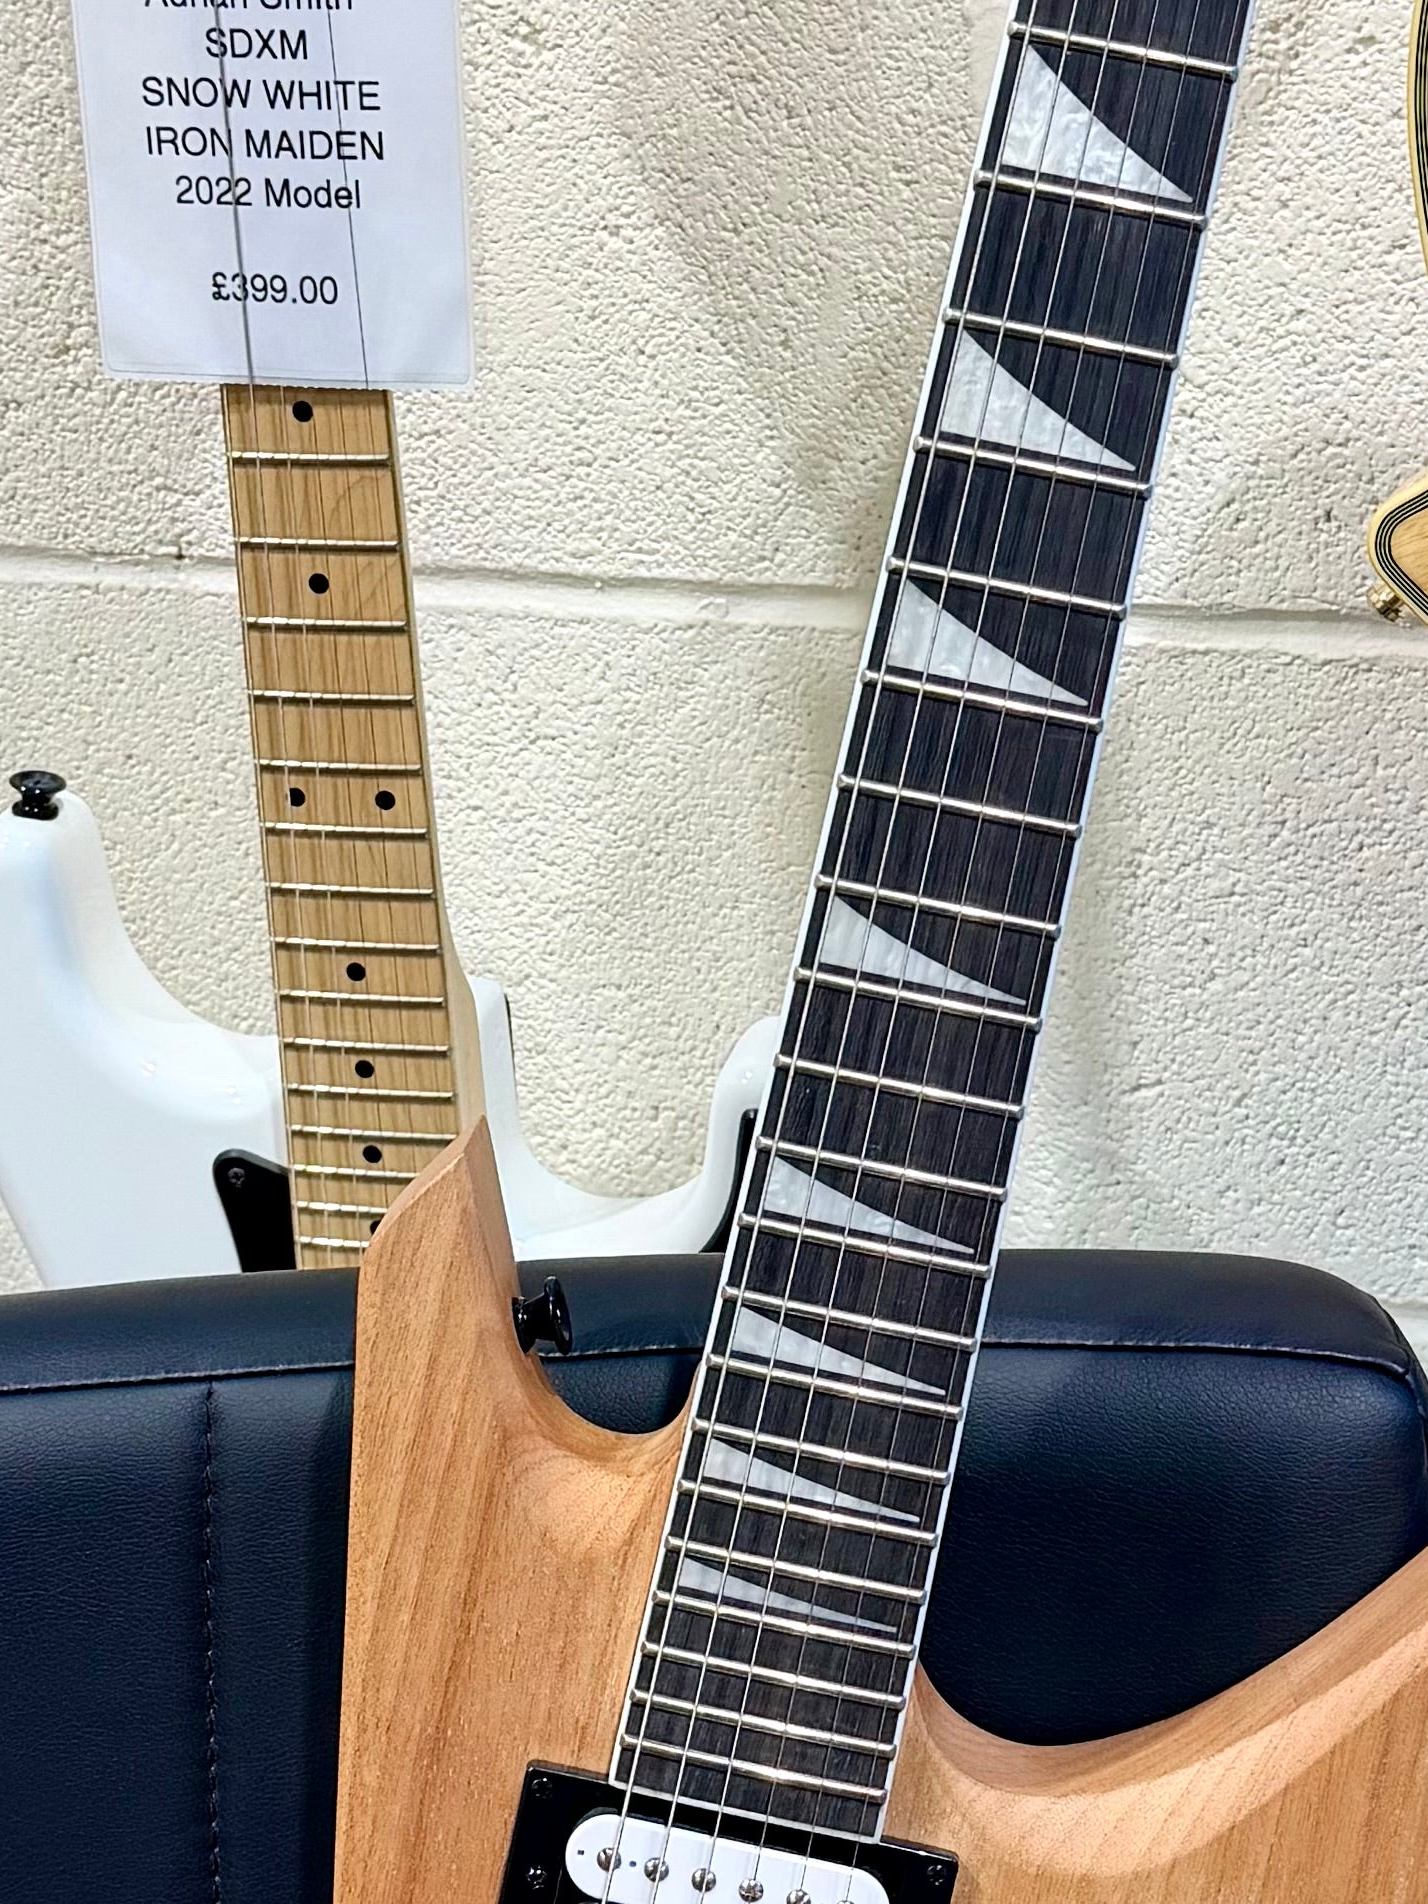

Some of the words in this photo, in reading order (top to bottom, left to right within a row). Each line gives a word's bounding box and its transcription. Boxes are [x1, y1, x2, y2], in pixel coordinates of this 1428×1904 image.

[204, 28, 309, 61] SDXM
[142, 77, 251, 110] SNOW
[262, 79, 381, 112] WHITE
[145, 125, 232, 159] IRON
[245, 128, 385, 162] MAIDEN
[175, 175, 253, 207] 2022
[264, 177, 362, 210] Model
[211, 271, 339, 306] £399.00
